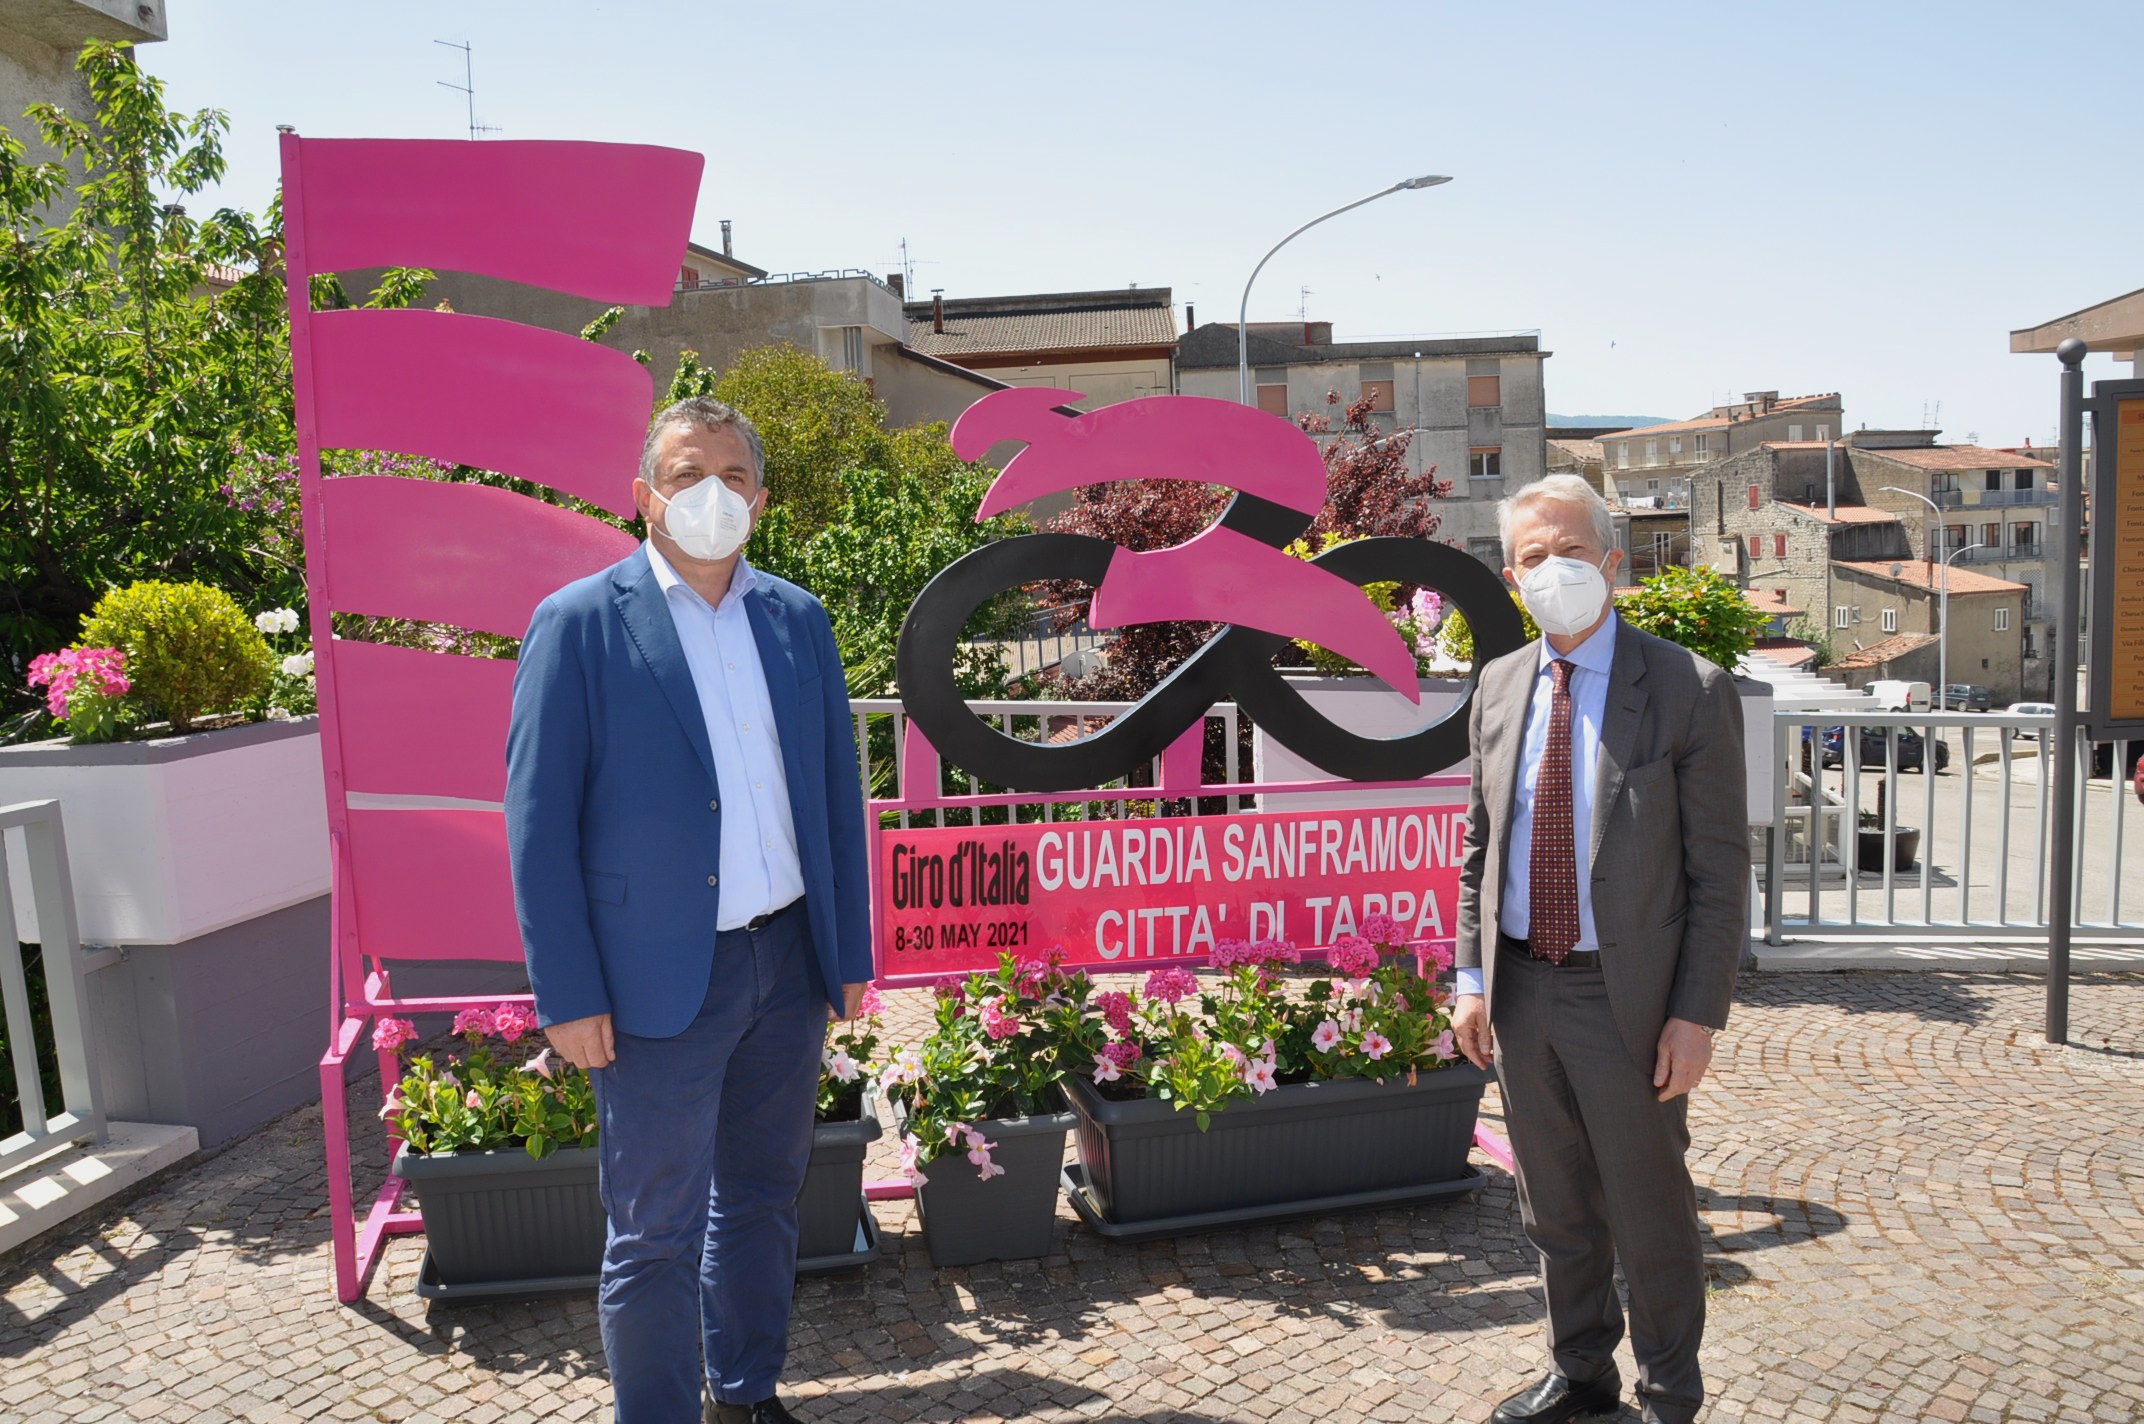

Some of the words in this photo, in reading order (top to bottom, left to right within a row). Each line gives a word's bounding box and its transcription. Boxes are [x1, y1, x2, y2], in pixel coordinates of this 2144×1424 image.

[892, 843, 943, 910] Giro
[949, 840, 1030, 907] d'Italia
[1036, 825, 1211, 891] GUARDIA
[1222, 813, 1466, 882] SANFRAMOND
[895, 926, 934, 951] 8-30
[941, 923, 982, 948] MAY
[987, 921, 1028, 947] 2021
[1095, 903, 1226, 960] CITTA'
[1250, 900, 1284, 947] DI
